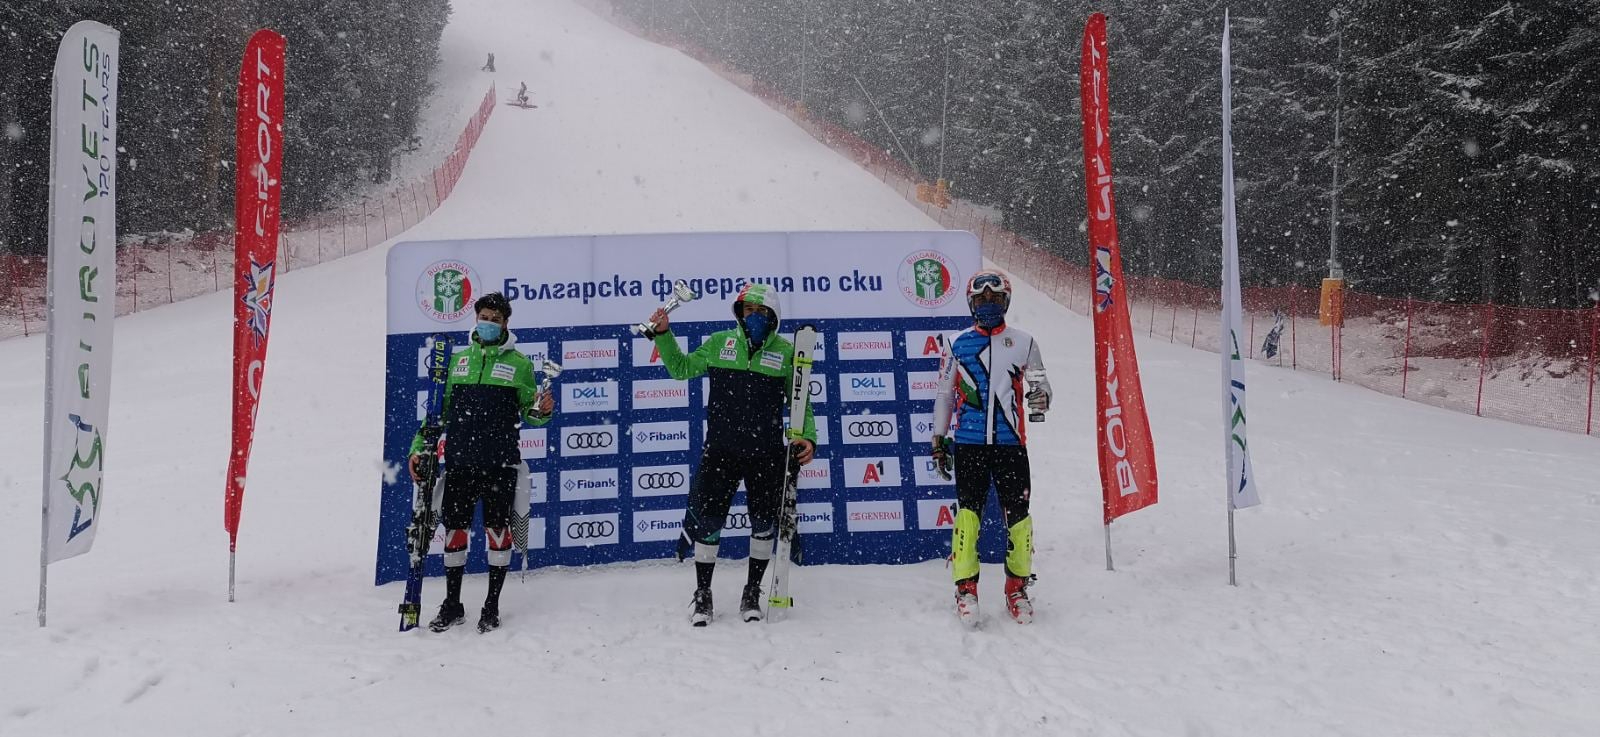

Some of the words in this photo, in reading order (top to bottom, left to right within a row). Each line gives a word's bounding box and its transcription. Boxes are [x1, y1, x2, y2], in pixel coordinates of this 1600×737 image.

[101, 51, 110, 143] YEARS
[99, 154, 111, 198] 120
[427, 262, 470, 277] BULGARIAN
[503, 274, 642, 305] Българска
[802, 275, 831, 293] по
[838, 269, 883, 292] ски
[853, 341, 891, 350] GENERALI
[922, 333, 944, 356] A1
[576, 349, 616, 359] GENERALI
[851, 377, 886, 389] DELL
[572, 387, 608, 399] DELL
[647, 389, 686, 399] GENERALI
[649, 431, 687, 441] Fibank
[518, 440, 545, 449] ERALI
[798, 470, 828, 478] NERALI
[863, 460, 884, 484] A1
[577, 478, 616, 489] Fibank
[861, 512, 901, 521] GENERALI
[650, 520, 681, 530] Fiban
